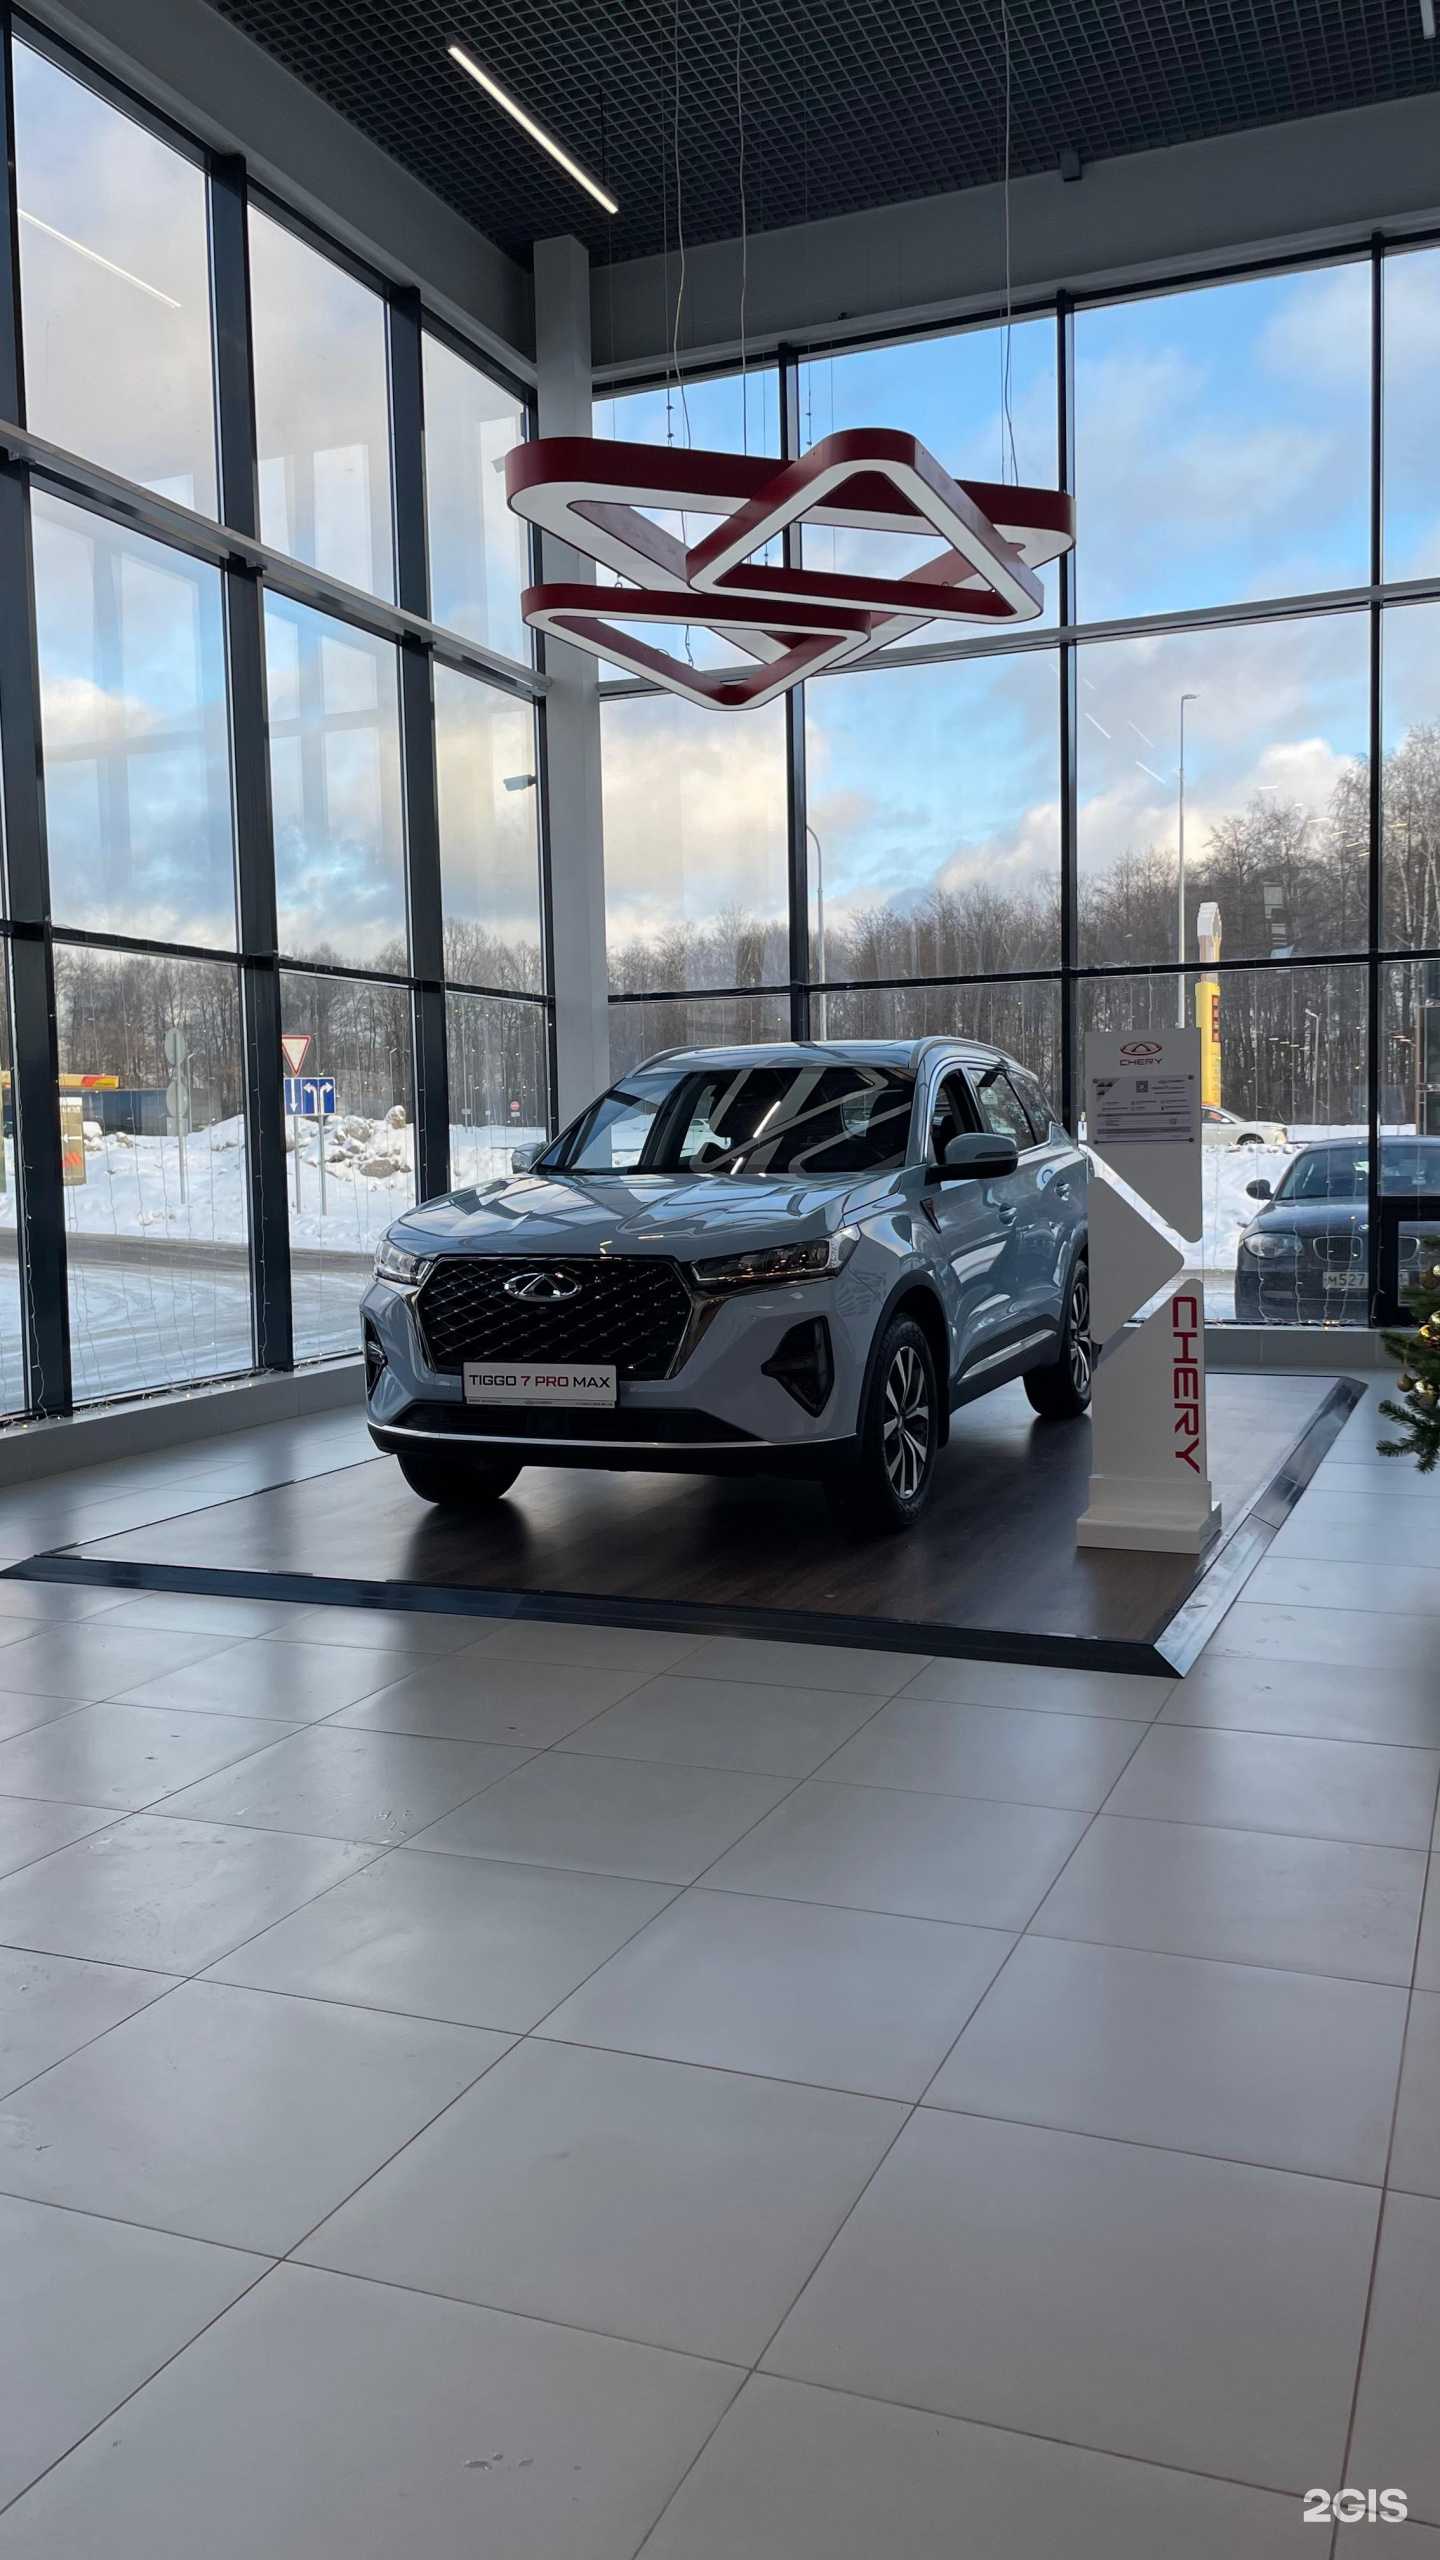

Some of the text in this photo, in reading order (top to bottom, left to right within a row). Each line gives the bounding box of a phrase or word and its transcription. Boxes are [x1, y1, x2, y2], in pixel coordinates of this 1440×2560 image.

[1120, 1057, 1163, 1066] CHERY
[469, 1374, 611, 1388] TIGGO 7 PRO MAX
[1172, 1296, 1201, 1474] CHERY
